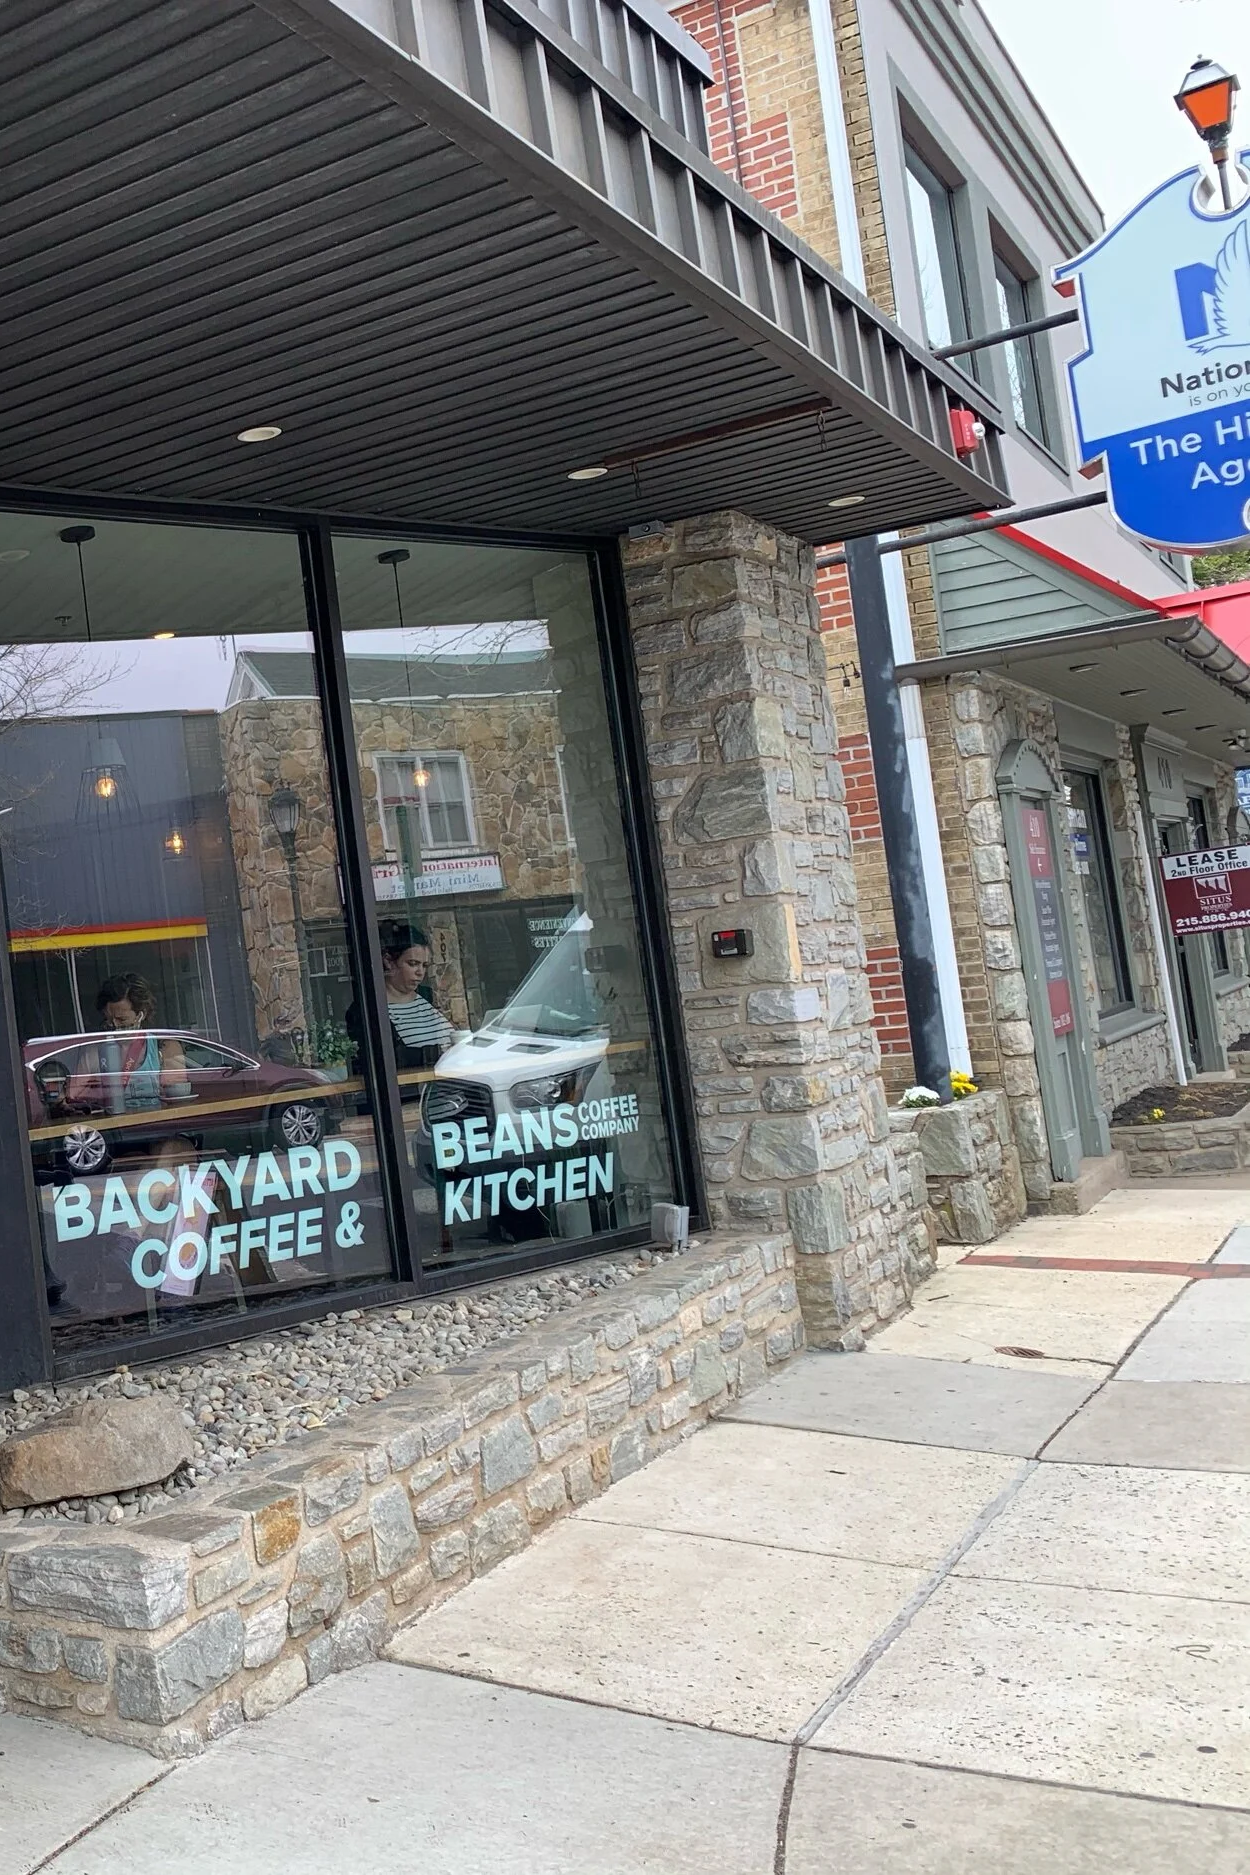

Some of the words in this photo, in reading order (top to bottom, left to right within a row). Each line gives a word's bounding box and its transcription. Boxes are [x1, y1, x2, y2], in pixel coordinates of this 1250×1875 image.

[1160, 360, 1250, 398] Natio
[1189, 396, 1202, 407] is
[1207, 388, 1228, 402] on
[1130, 432, 1202, 466] The
[1191, 458, 1250, 490] Ag
[1175, 848, 1239, 868] LEASE
[1189, 865, 1214, 875] Floor
[1217, 860, 1248, 871] Office
[1199, 894, 1232, 906] SITUS
[432, 1103, 579, 1169] BEANS
[577, 1093, 639, 1123] COFFEE
[581, 1115, 640, 1141] COMPANY
[52, 1140, 362, 1242] BACKYARD
[444, 1151, 614, 1226] KITCHEN
[131, 1207, 323, 1289] COFFEE
[335, 1200, 365, 1249] &
